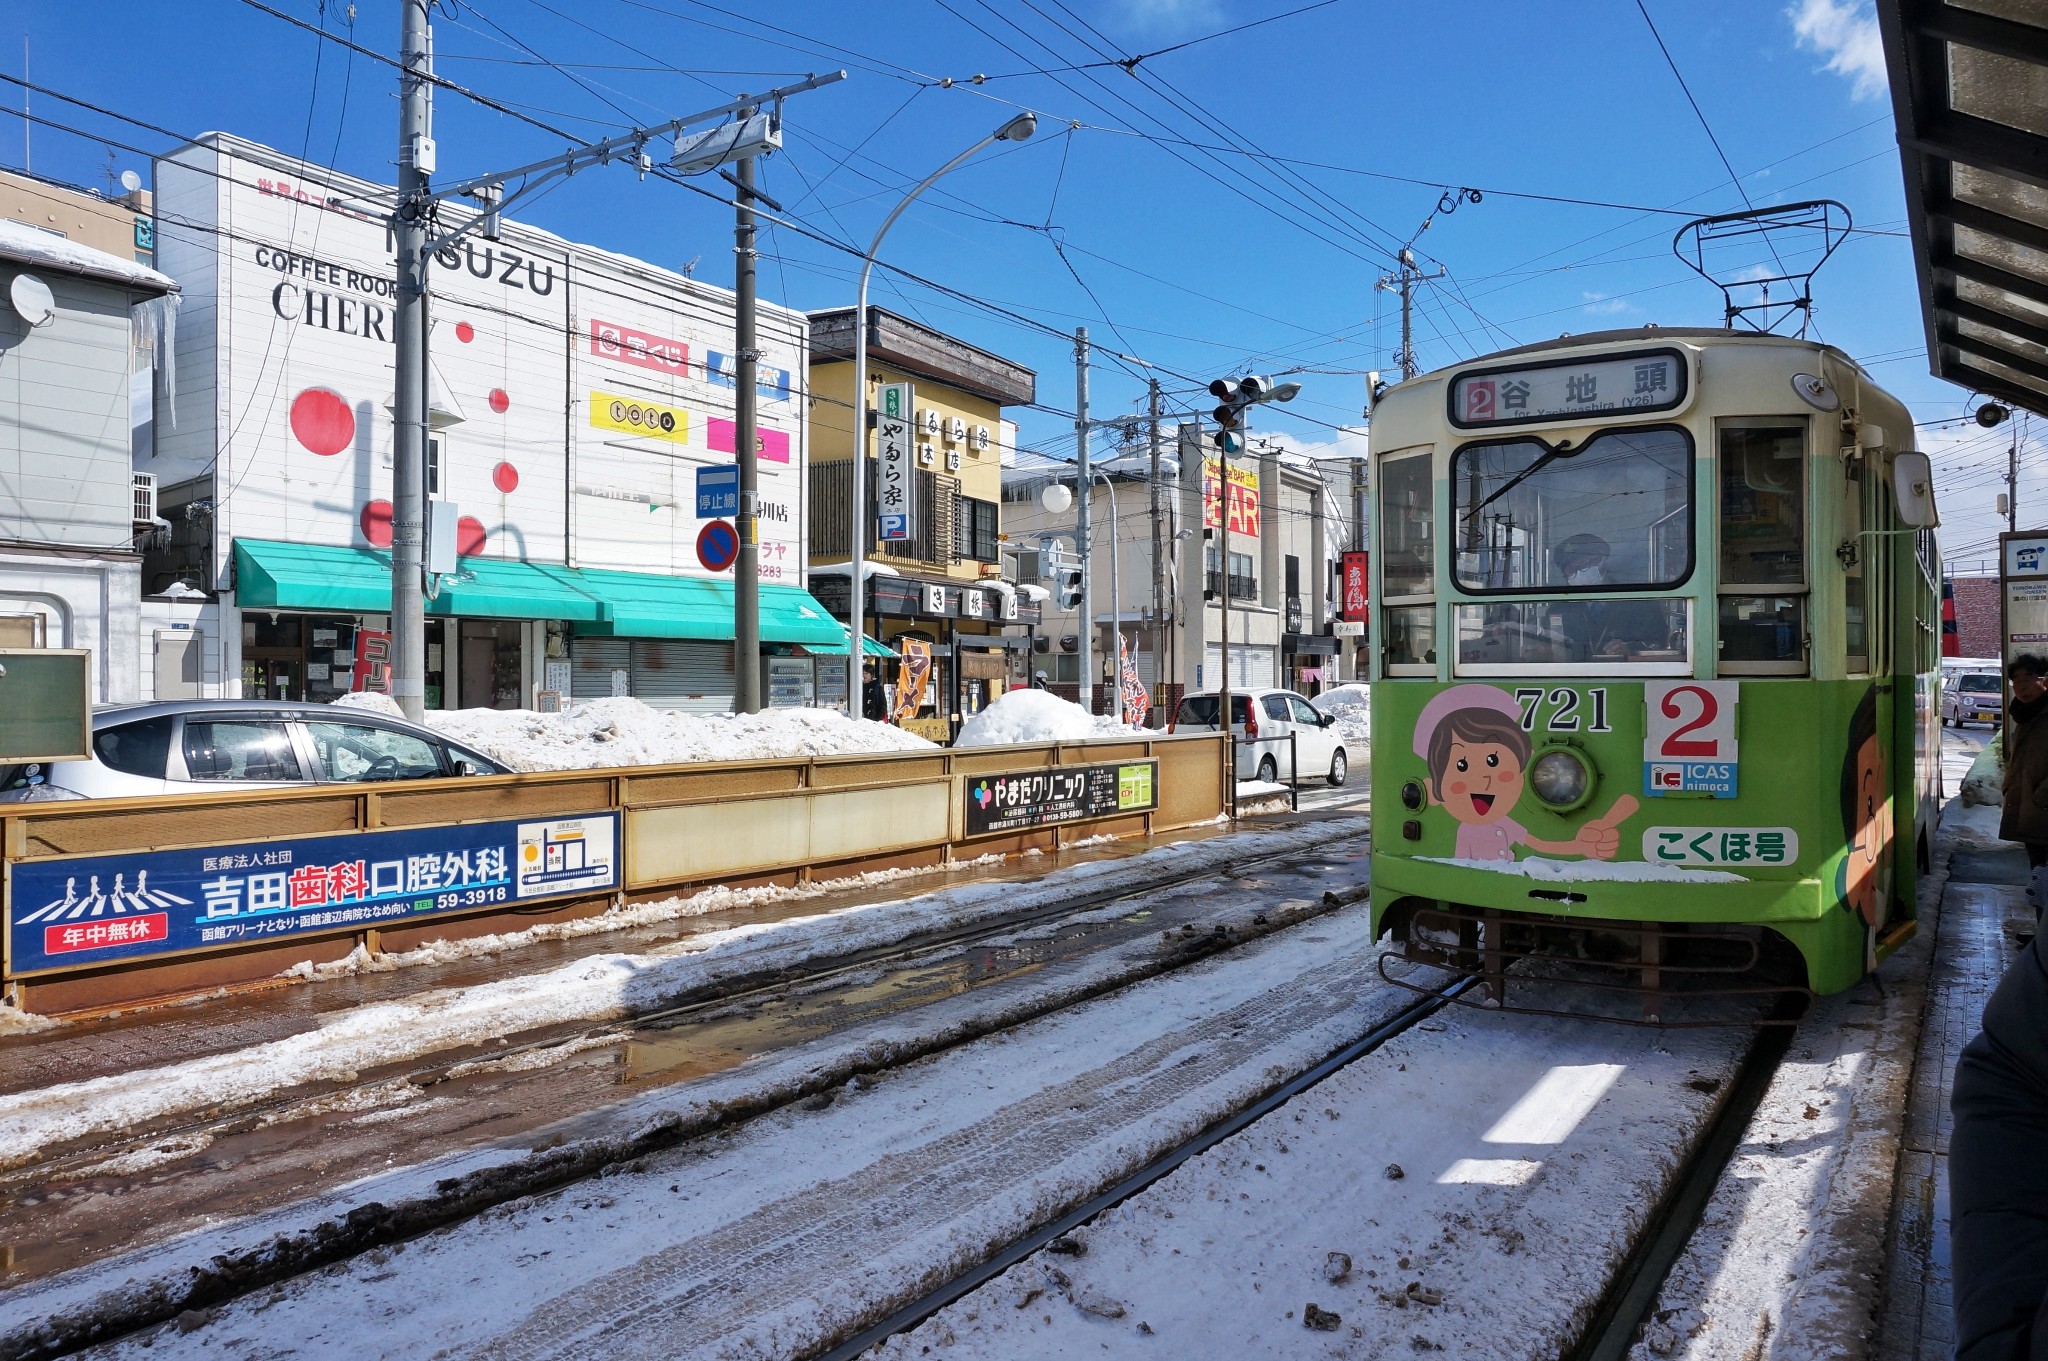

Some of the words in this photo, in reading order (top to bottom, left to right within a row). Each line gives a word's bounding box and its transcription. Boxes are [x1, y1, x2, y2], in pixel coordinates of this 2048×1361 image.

[256, 246, 341, 286] COFFEE
[626, 335, 682, 368] 宝くじ
[610, 400, 676, 433] toto
[1469, 388, 1492, 419] 2
[698, 493, 737, 510] 停止線
[1515, 687, 1612, 732] 721
[1660, 685, 1719, 757] 2
[1686, 764, 1730, 780] ICAS
[1686, 779, 1730, 792] nimoca
[995, 773, 1086, 807] やまだクリニック
[203, 850, 293, 872] 医療法人社団
[548, 856, 562, 866] 当院
[1656, 831, 1787, 863] こくほ号
[201, 846, 508, 918] 吉田歯科口腔外科
[416, 901, 433, 909] TEL
[437, 887, 507, 910] 59-3918
[62, 919, 151, 947] 年中無休
